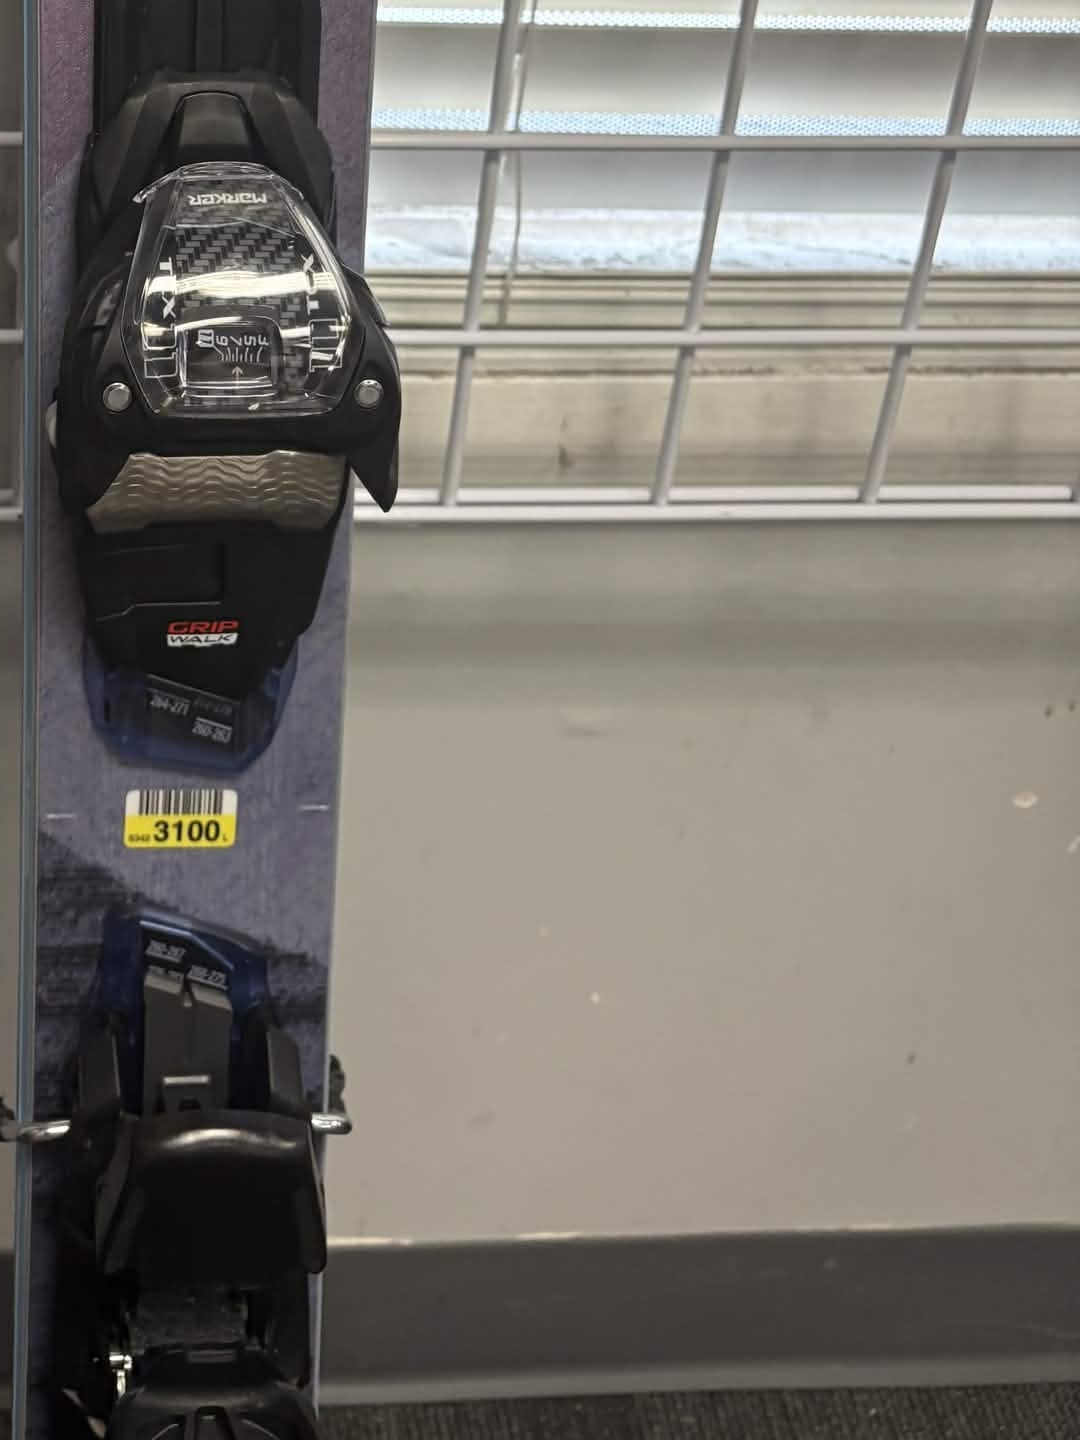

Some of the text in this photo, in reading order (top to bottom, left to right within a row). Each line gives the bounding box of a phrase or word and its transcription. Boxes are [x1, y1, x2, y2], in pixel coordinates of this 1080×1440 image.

[168, 620, 239, 633] GRIP
[170, 634, 235, 643] WALK
[153, 820, 221, 842] 3100
